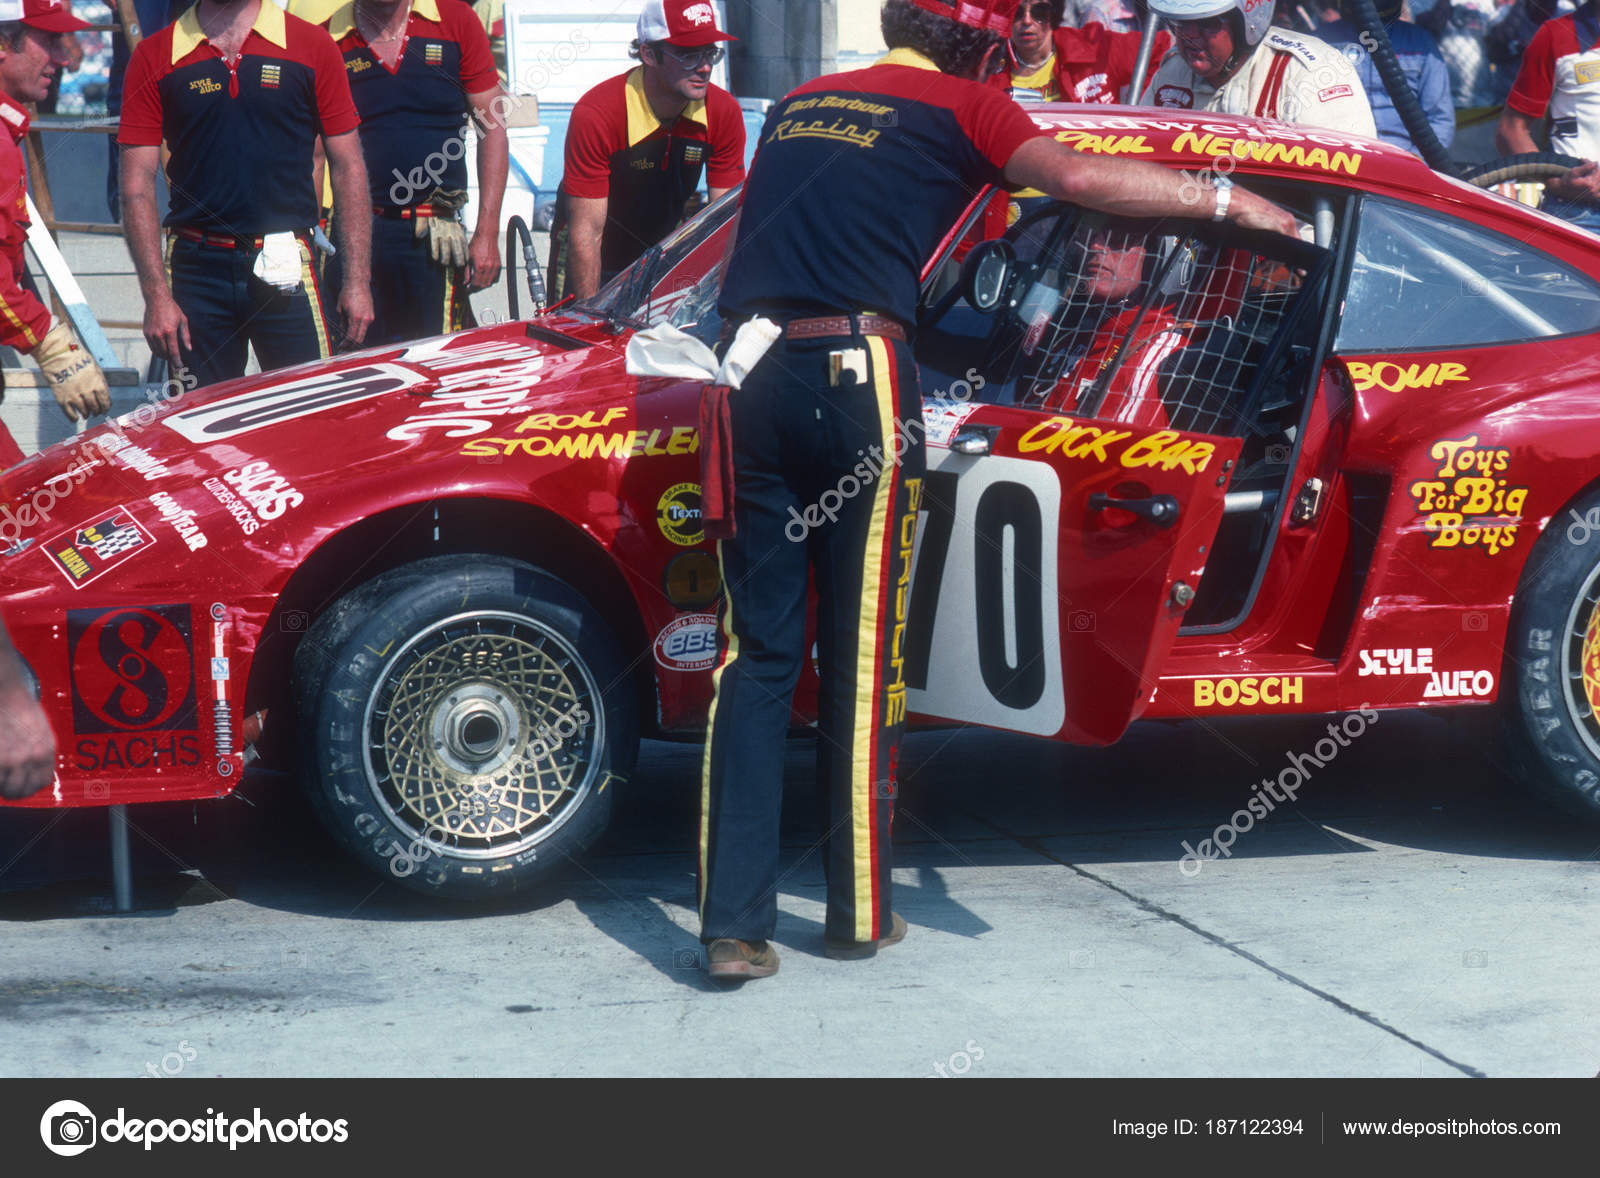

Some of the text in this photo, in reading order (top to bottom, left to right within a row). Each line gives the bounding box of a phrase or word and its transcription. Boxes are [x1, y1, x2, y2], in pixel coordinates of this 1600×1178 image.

[765, 117, 881, 148] Racing
[1054, 130, 1362, 175] PAUL NEWMAN
[1346, 361, 1471, 393] BOUR
[514, 406, 629, 433] ROLF
[1018, 416, 1132, 462] DICK
[1431, 435, 1510, 478] Toys
[223, 461, 304, 520] SACHS
[1411, 477, 1529, 520] For Big
[148, 491, 208, 552] GOODYEAR
[1424, 512, 1518, 556] Boys
[885, 478, 922, 727] PORSCHE
[1358, 648, 1433, 676] STYLE
[1423, 670, 1494, 697] AUTO
[1194, 677, 1303, 707] BOSCH
[76, 735, 201, 771] SACHS
